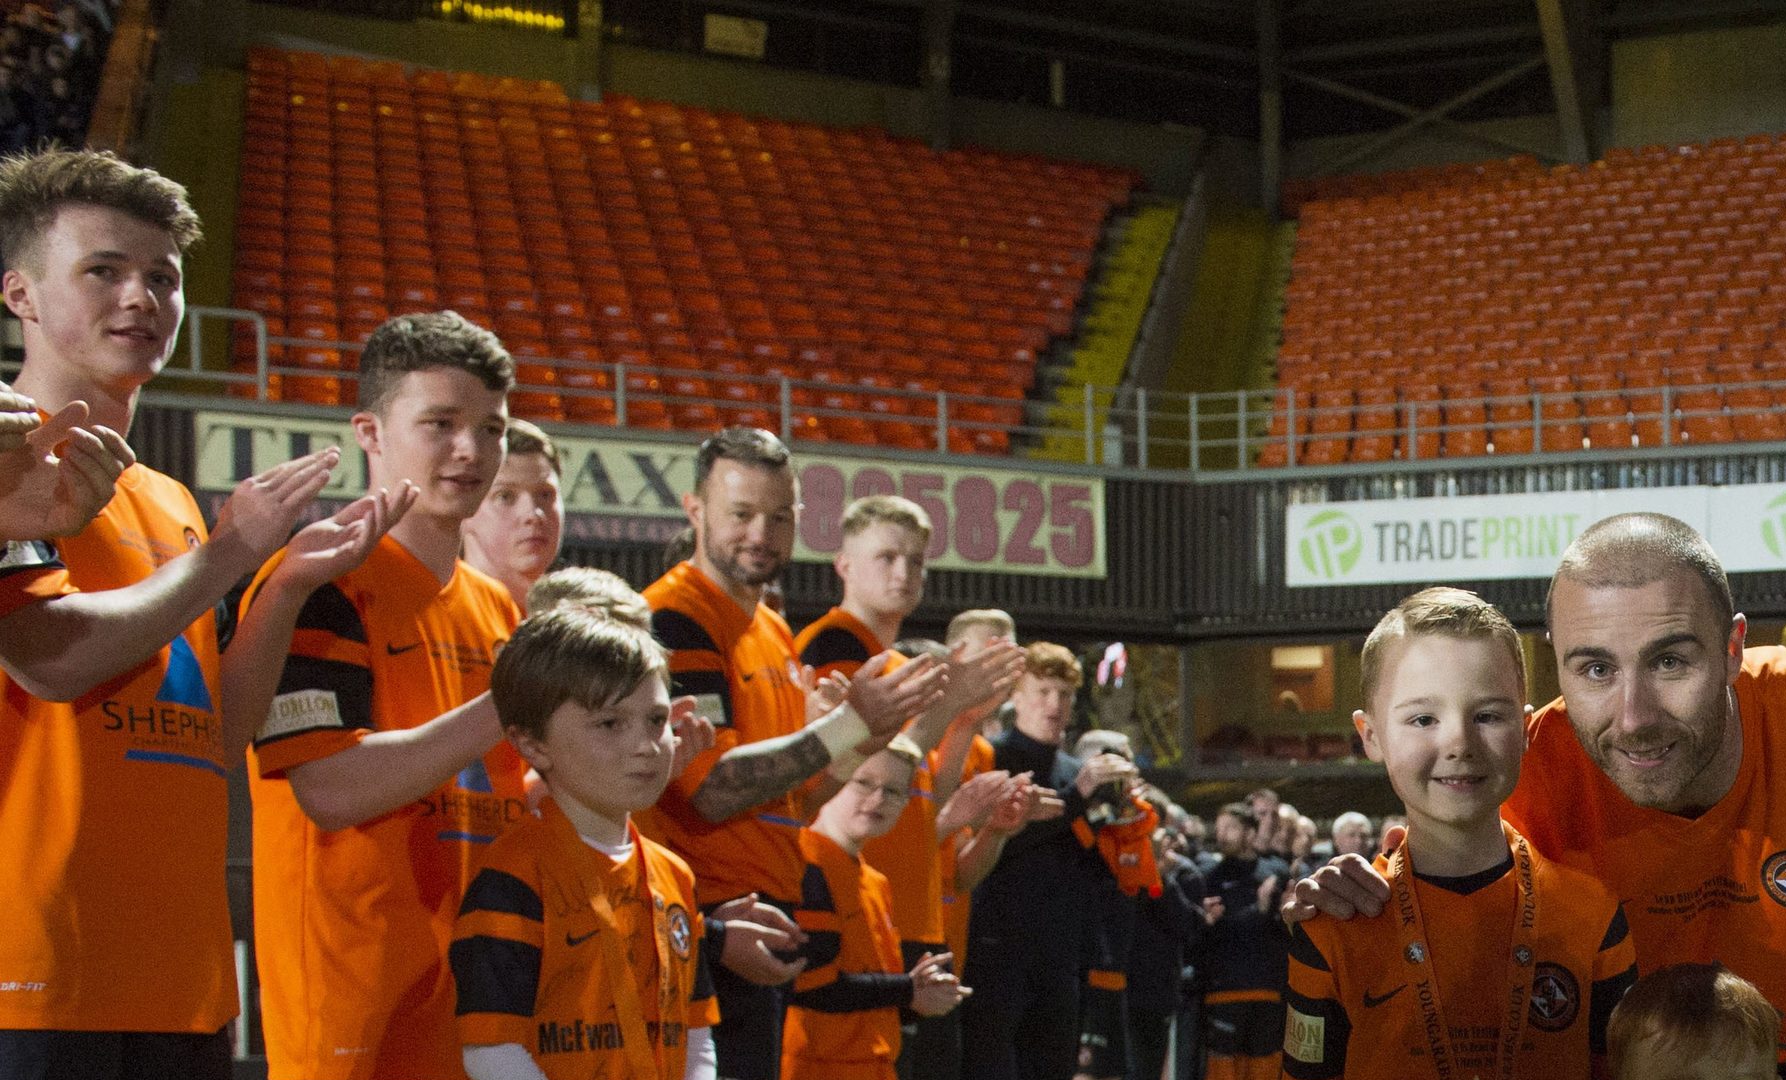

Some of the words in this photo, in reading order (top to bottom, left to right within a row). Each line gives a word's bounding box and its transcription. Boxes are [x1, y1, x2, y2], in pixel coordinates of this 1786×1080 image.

[562, 446, 692, 508] AX
[800, 463, 1096, 569] 85825
[1373, 512, 1580, 563] TRADEPRINT
[101, 700, 211, 739] SHEPH
